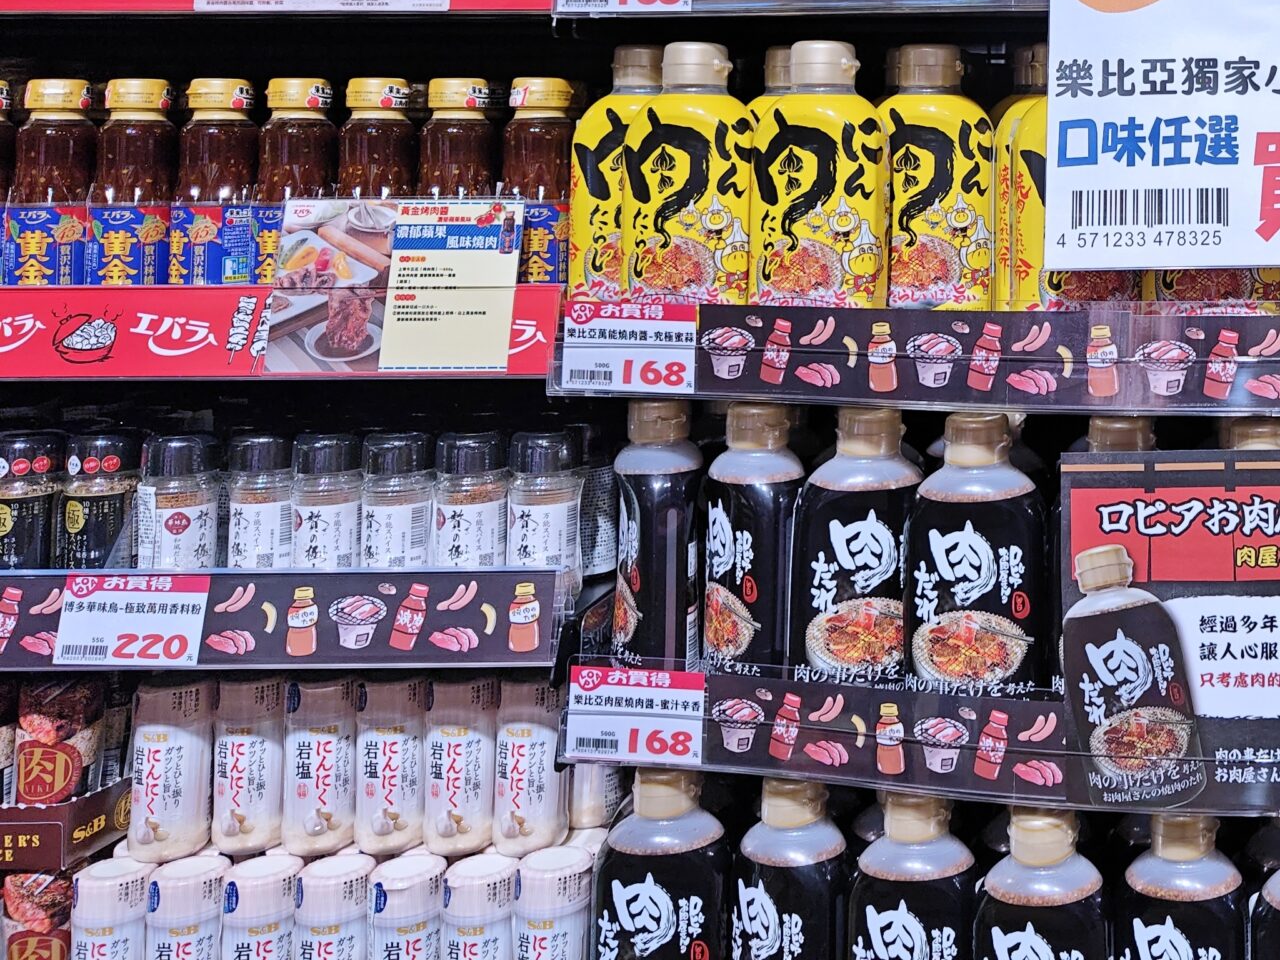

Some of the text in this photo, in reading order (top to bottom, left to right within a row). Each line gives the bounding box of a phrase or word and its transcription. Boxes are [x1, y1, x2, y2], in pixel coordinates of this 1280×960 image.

[1057, 115, 1240, 168] 口味任選
[18, 210, 53, 225] エバラ
[396, 225, 447, 238] 濃郁蘋果
[446, 235, 498, 249] 風味燒肉
[1056, 230, 1223, 248] 4 571233 478325
[600, 303, 664, 319] お買得
[130, 312, 219, 356] エバラ
[567, 327, 694, 343] 樂比亞萬能燒肉醬-究極蜜蒜
[622, 359, 686, 387] 168
[928, 519, 998, 607] 肉
[103, 576, 173, 591] お買得
[913, 560, 940, 625] だれ
[64, 601, 202, 616] 博多華味鳥-極致萬用香料粉
[112, 633, 189, 660] 220
[607, 671, 671, 687] お買得
[574, 694, 700, 712] 樂比亞肉屋燒肉醬-蜜汁辛香
[440, 727, 469, 737] S&B
[628, 728, 693, 756] 168
[295, 741, 313, 779] 岩塩
[315, 740, 333, 807] にんにく
[430, 741, 445, 779] 岩塩
[447, 742, 463, 808] にんにく
[72, 815, 106, 843] S&B
